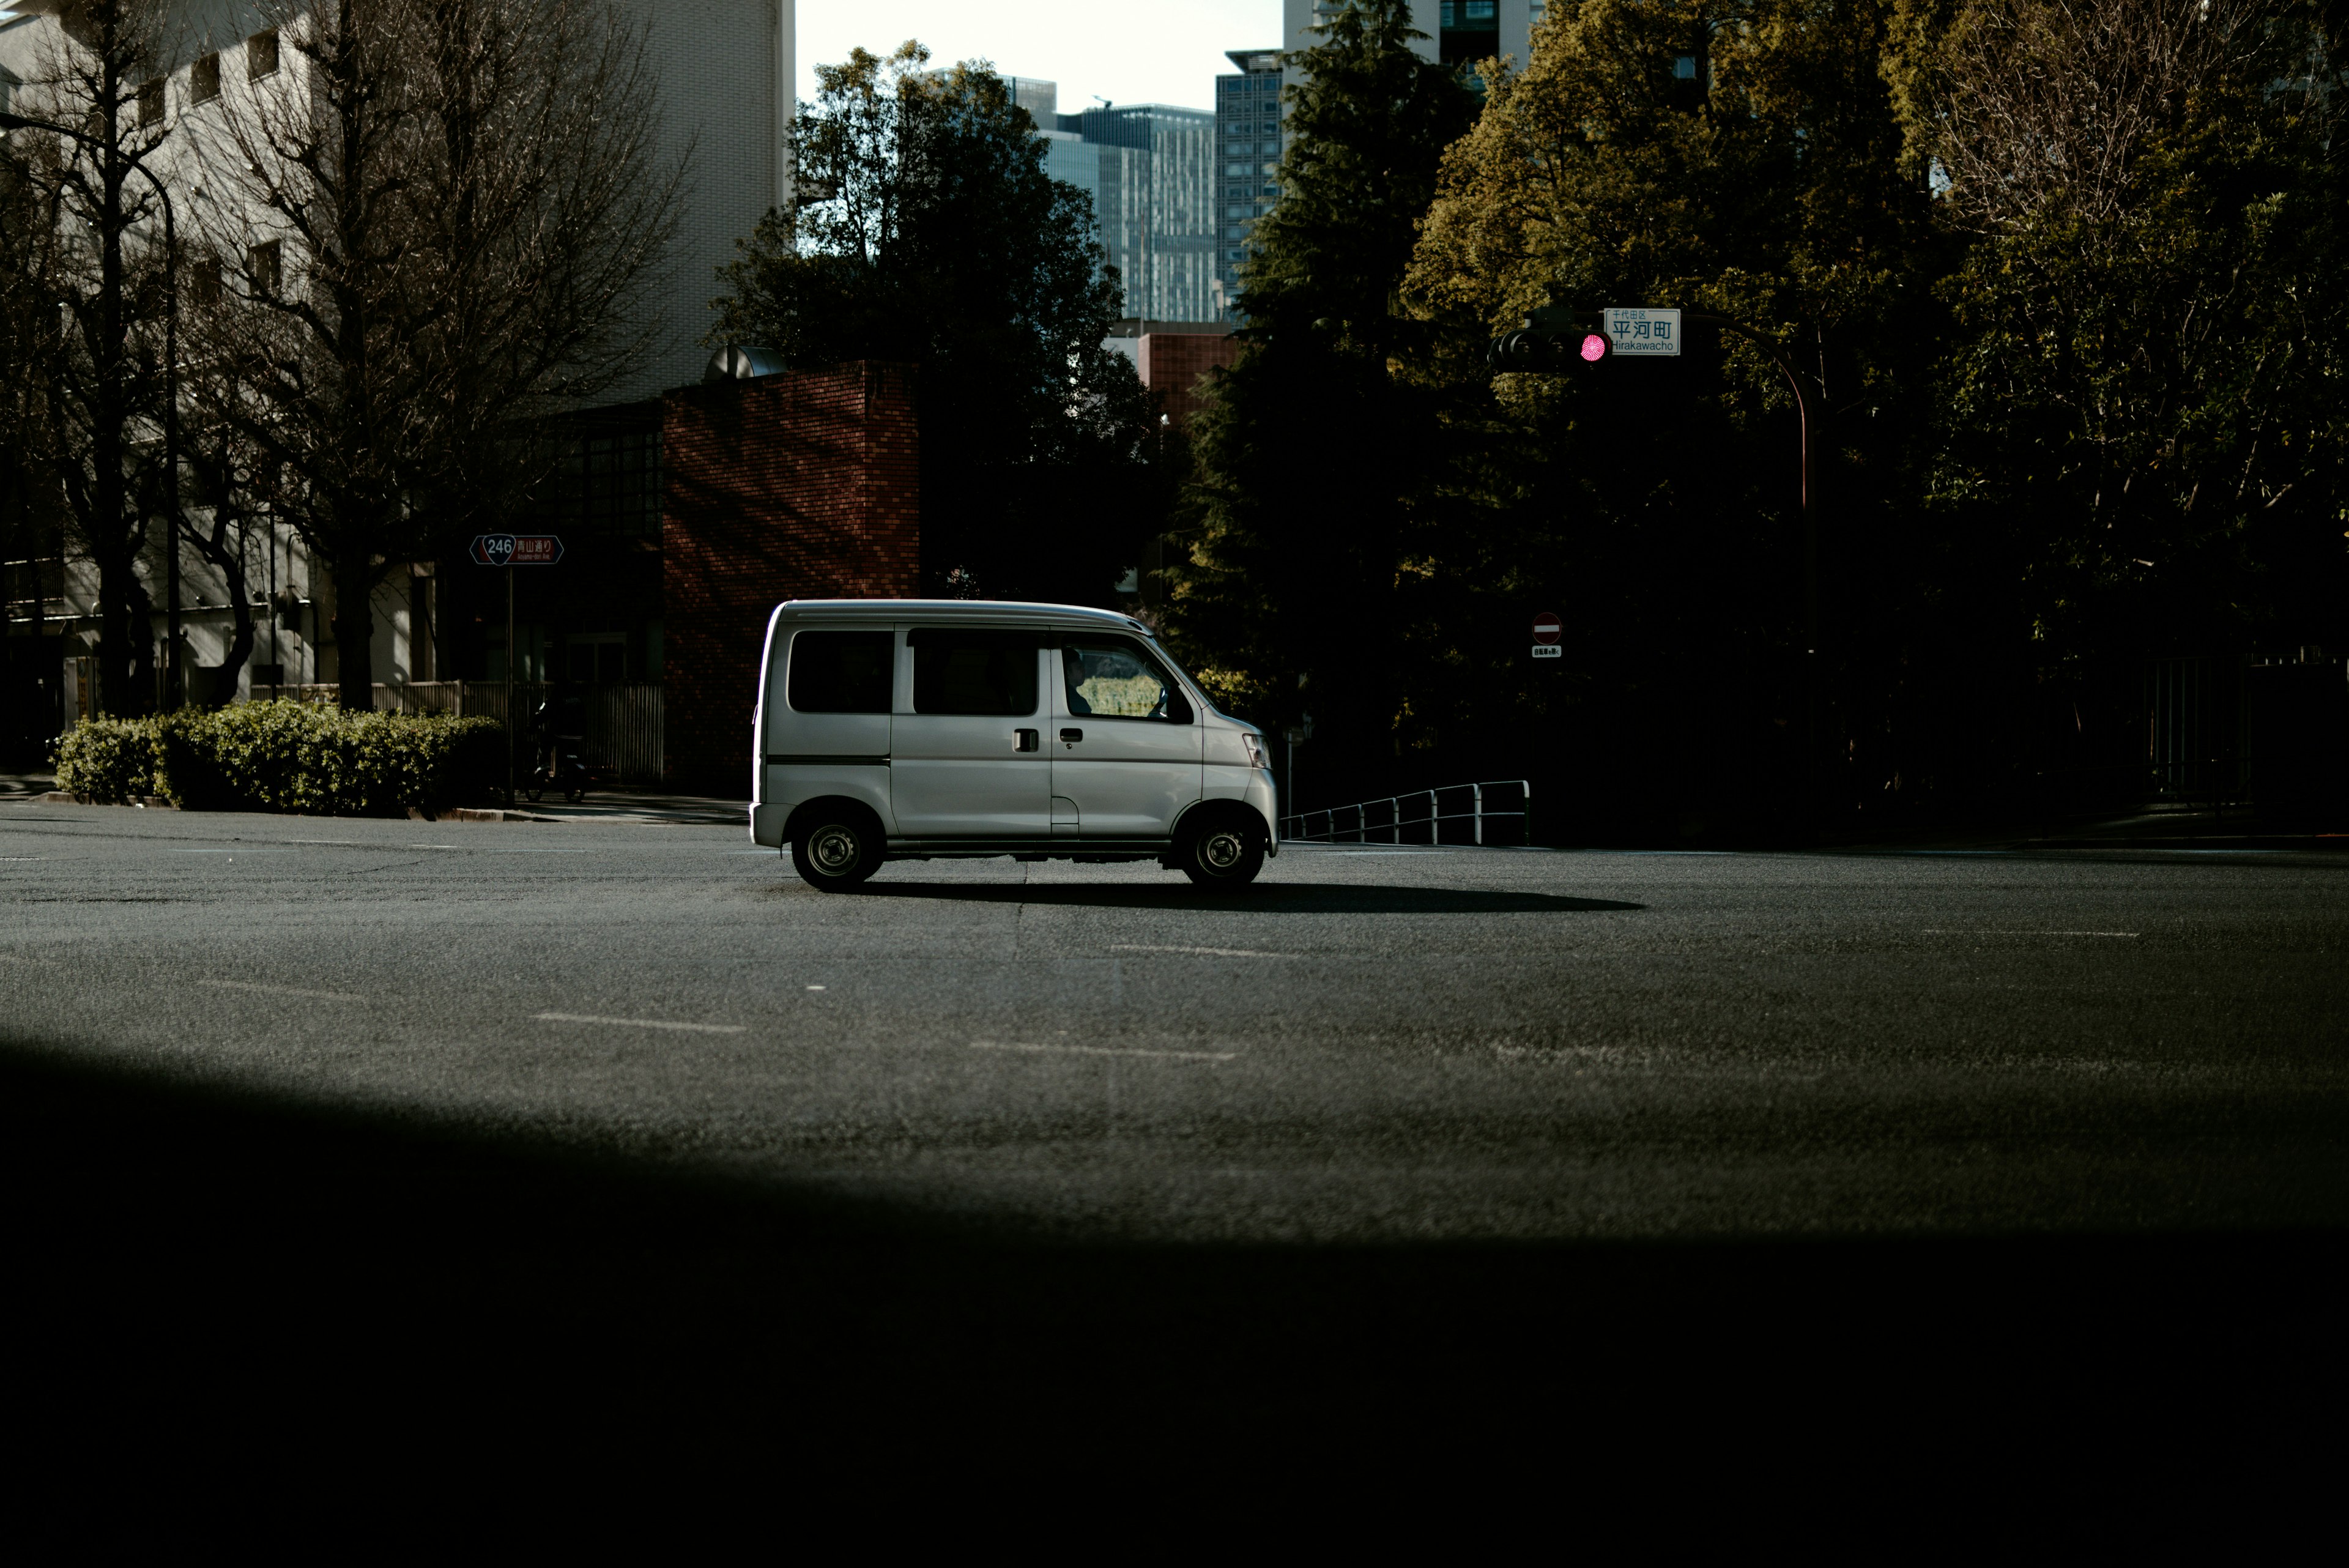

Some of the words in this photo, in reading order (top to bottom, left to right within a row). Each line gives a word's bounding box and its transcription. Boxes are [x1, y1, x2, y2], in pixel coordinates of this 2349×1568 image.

[1613, 310, 1646, 319] 千代田区
[1613, 321, 1672, 339] 平河町
[1612, 341, 1673, 351] Hirakawacho
[488, 539, 512, 554] 246
[518, 540, 551, 553] 青山通り
